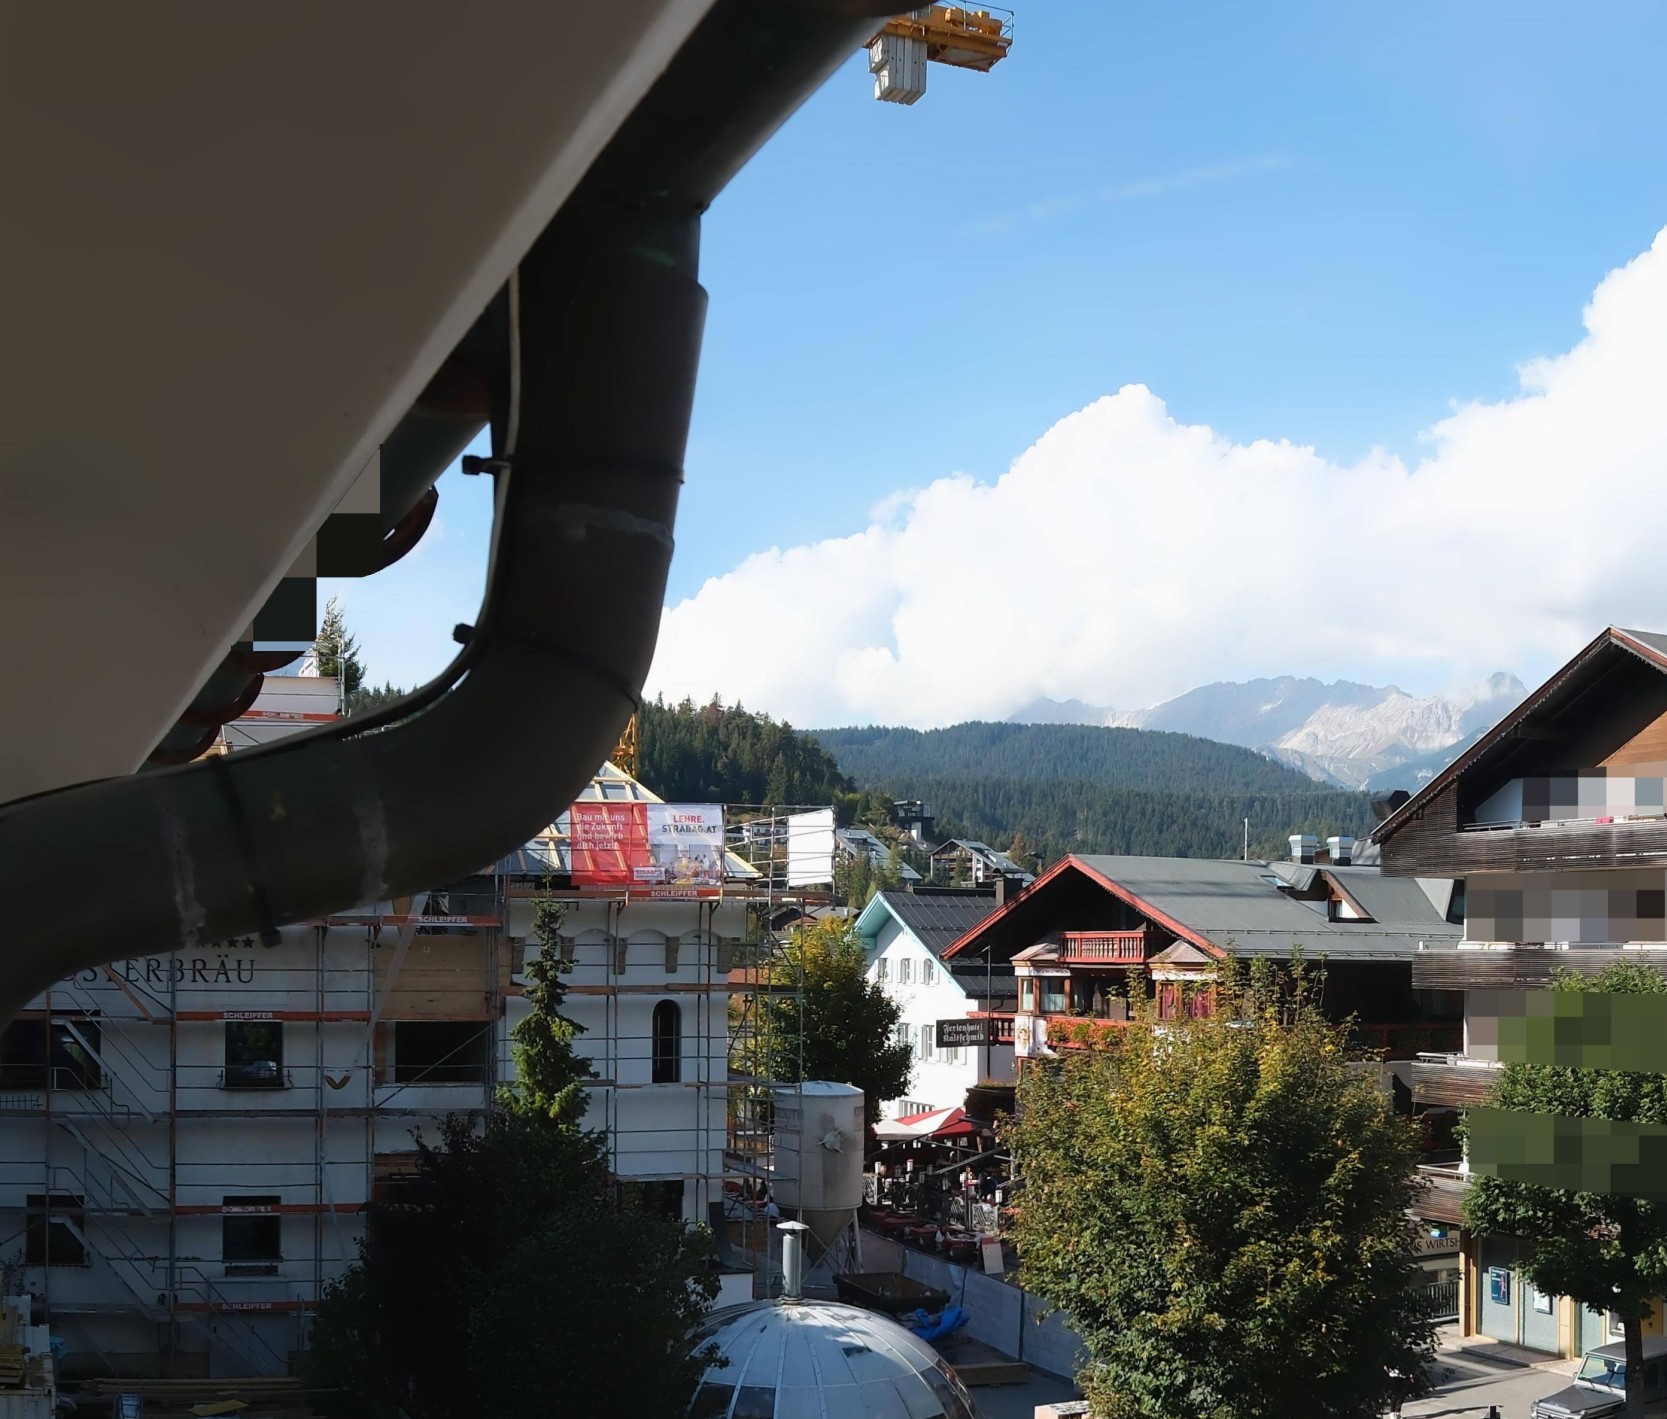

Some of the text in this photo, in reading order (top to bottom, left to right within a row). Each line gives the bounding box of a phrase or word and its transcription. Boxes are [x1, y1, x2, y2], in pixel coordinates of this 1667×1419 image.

[576, 812, 592, 822] Bau
[610, 813, 625, 822] uns
[673, 814, 705, 823] LEHRE.
[661, 824, 716, 834] STRABAG.AT
[576, 841, 594, 849] dich
